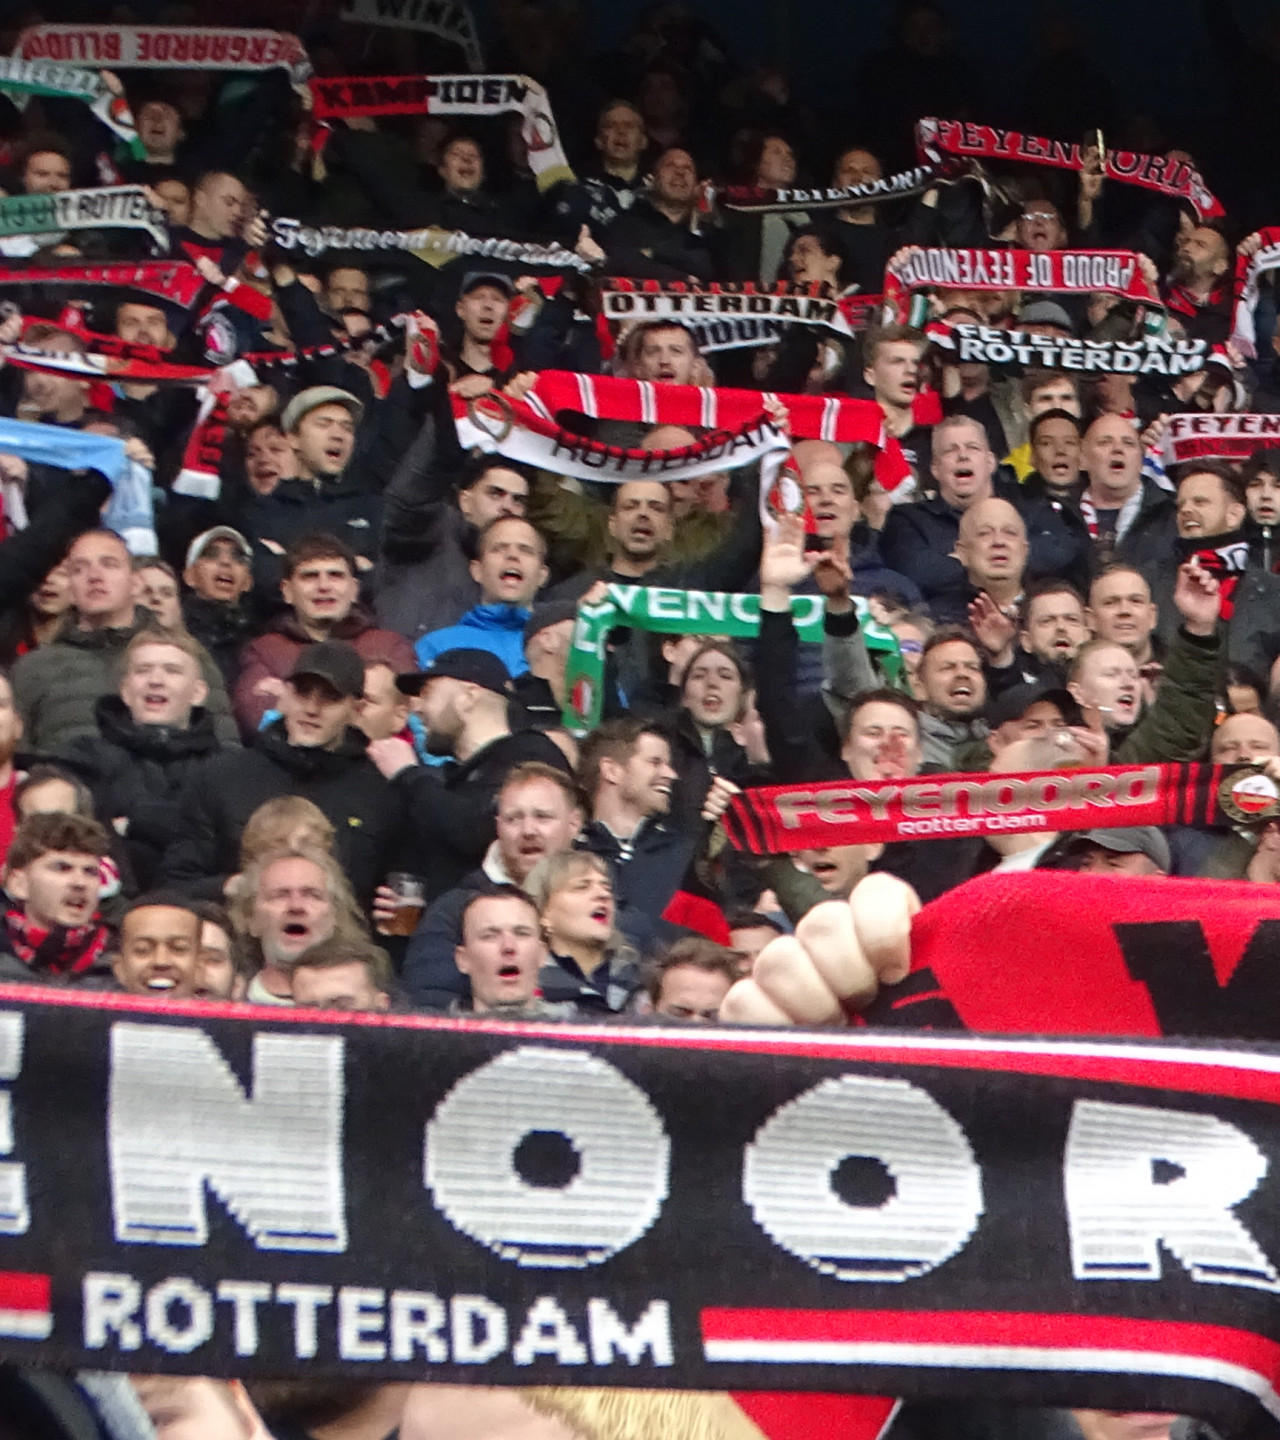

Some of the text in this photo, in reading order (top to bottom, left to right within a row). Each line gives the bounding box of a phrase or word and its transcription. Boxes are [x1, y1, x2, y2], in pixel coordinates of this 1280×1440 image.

[902, 248, 1136, 290] PROUD OF FEYENOOR
[960, 338, 1204, 375] ROTTERDAM
[896, 812, 1049, 838] Rotterdam
[81, 1271, 674, 1368] ROTTERDAM
